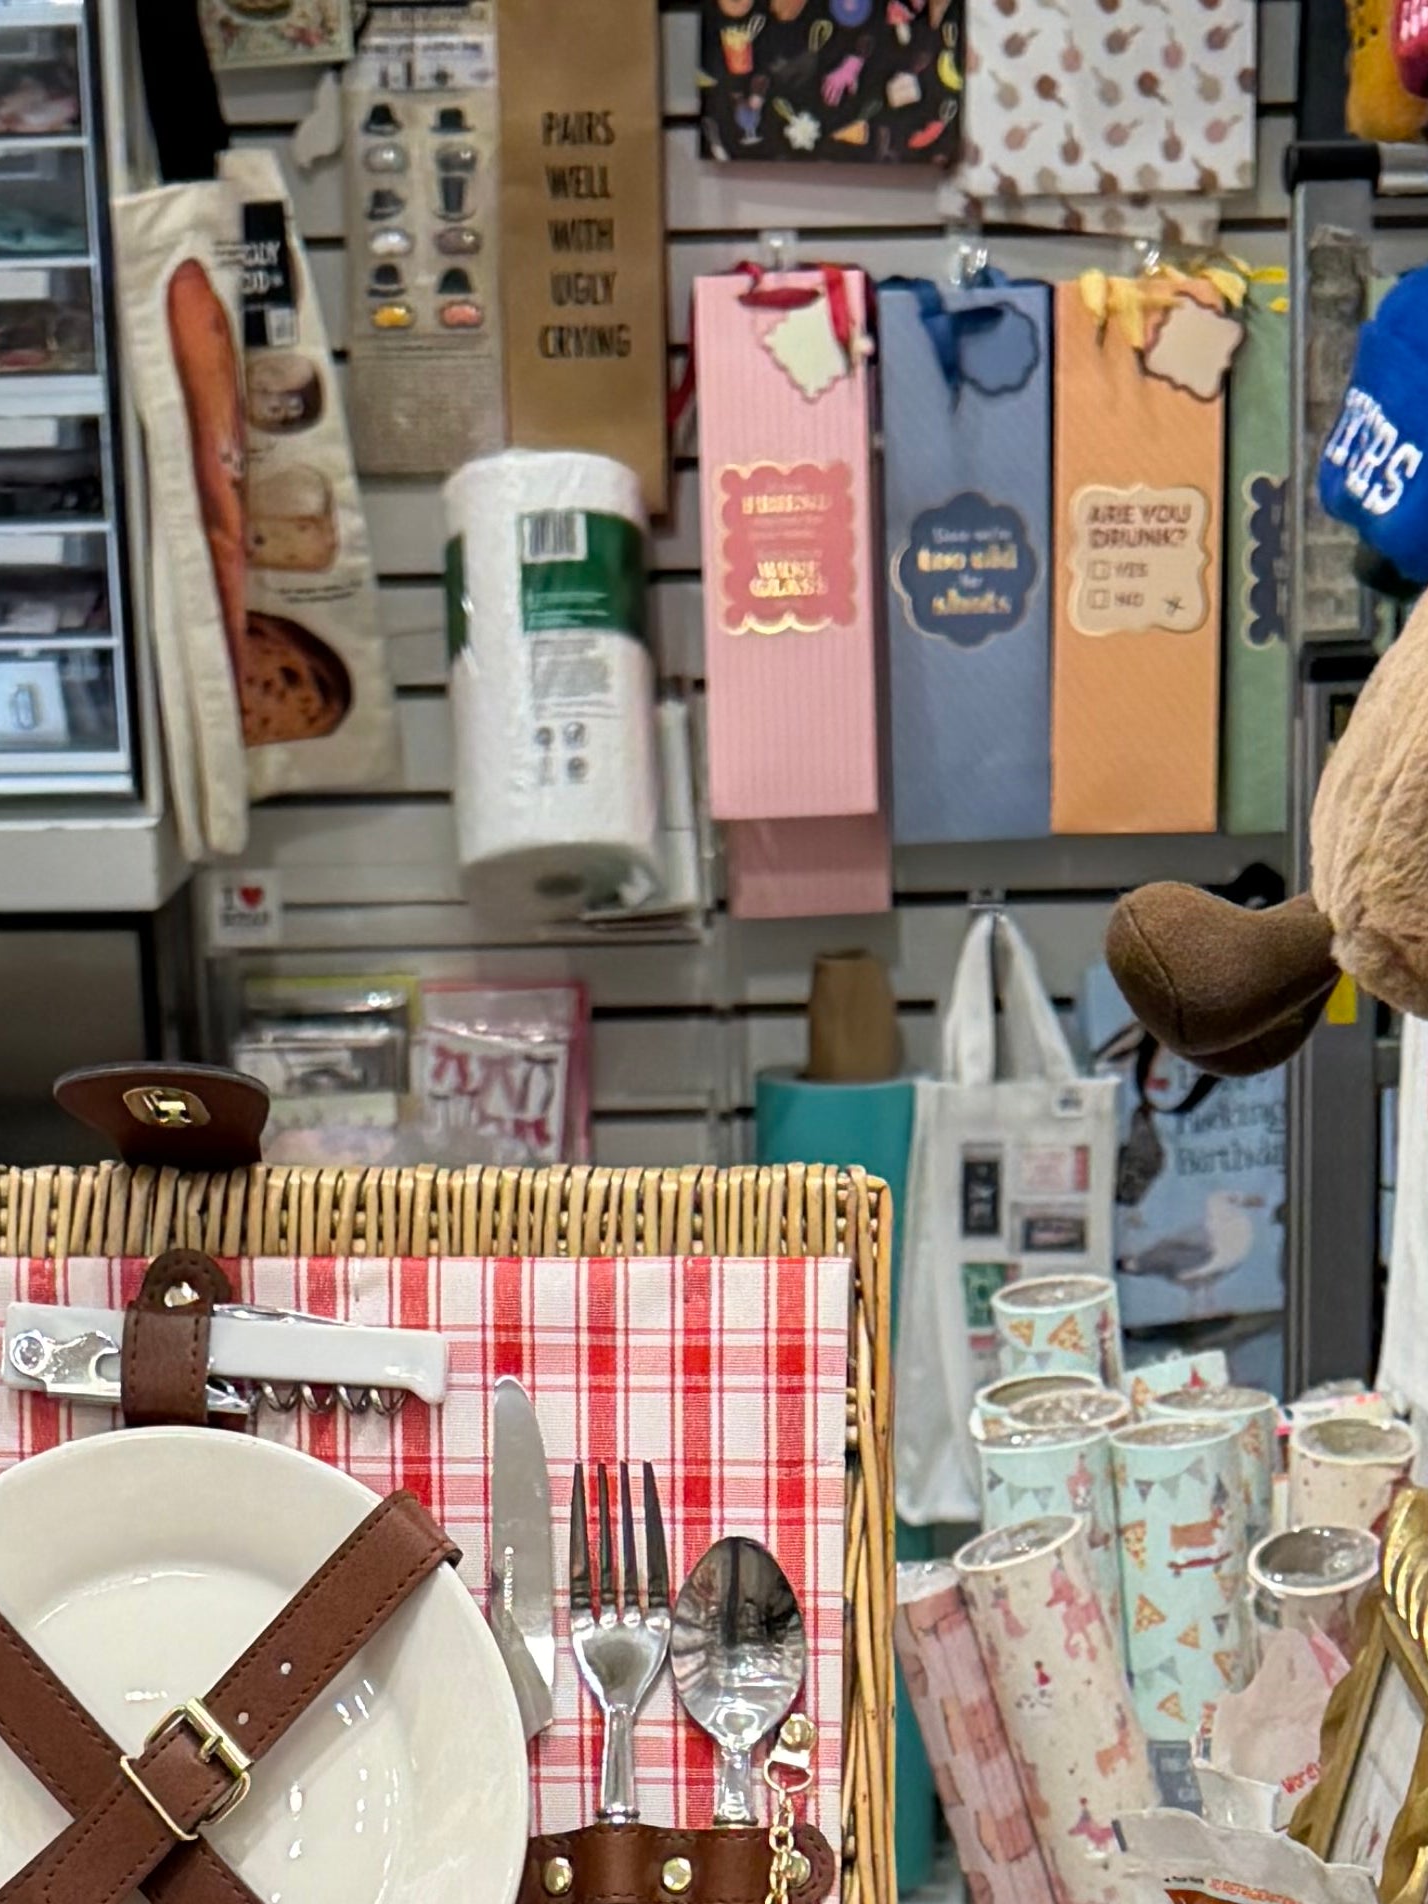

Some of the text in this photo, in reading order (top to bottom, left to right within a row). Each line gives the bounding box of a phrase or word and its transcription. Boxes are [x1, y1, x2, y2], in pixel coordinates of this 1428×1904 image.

[542, 110, 615, 147] PAIRS
[545, 165, 613, 199] WELL
[548, 219, 615, 253] WITH
[550, 270, 617, 306] UGLY
[539, 325, 632, 359] CRYING
[1087, 504, 1192, 525] ARE YOU
[1089, 529, 1187, 549] DRUNK?
